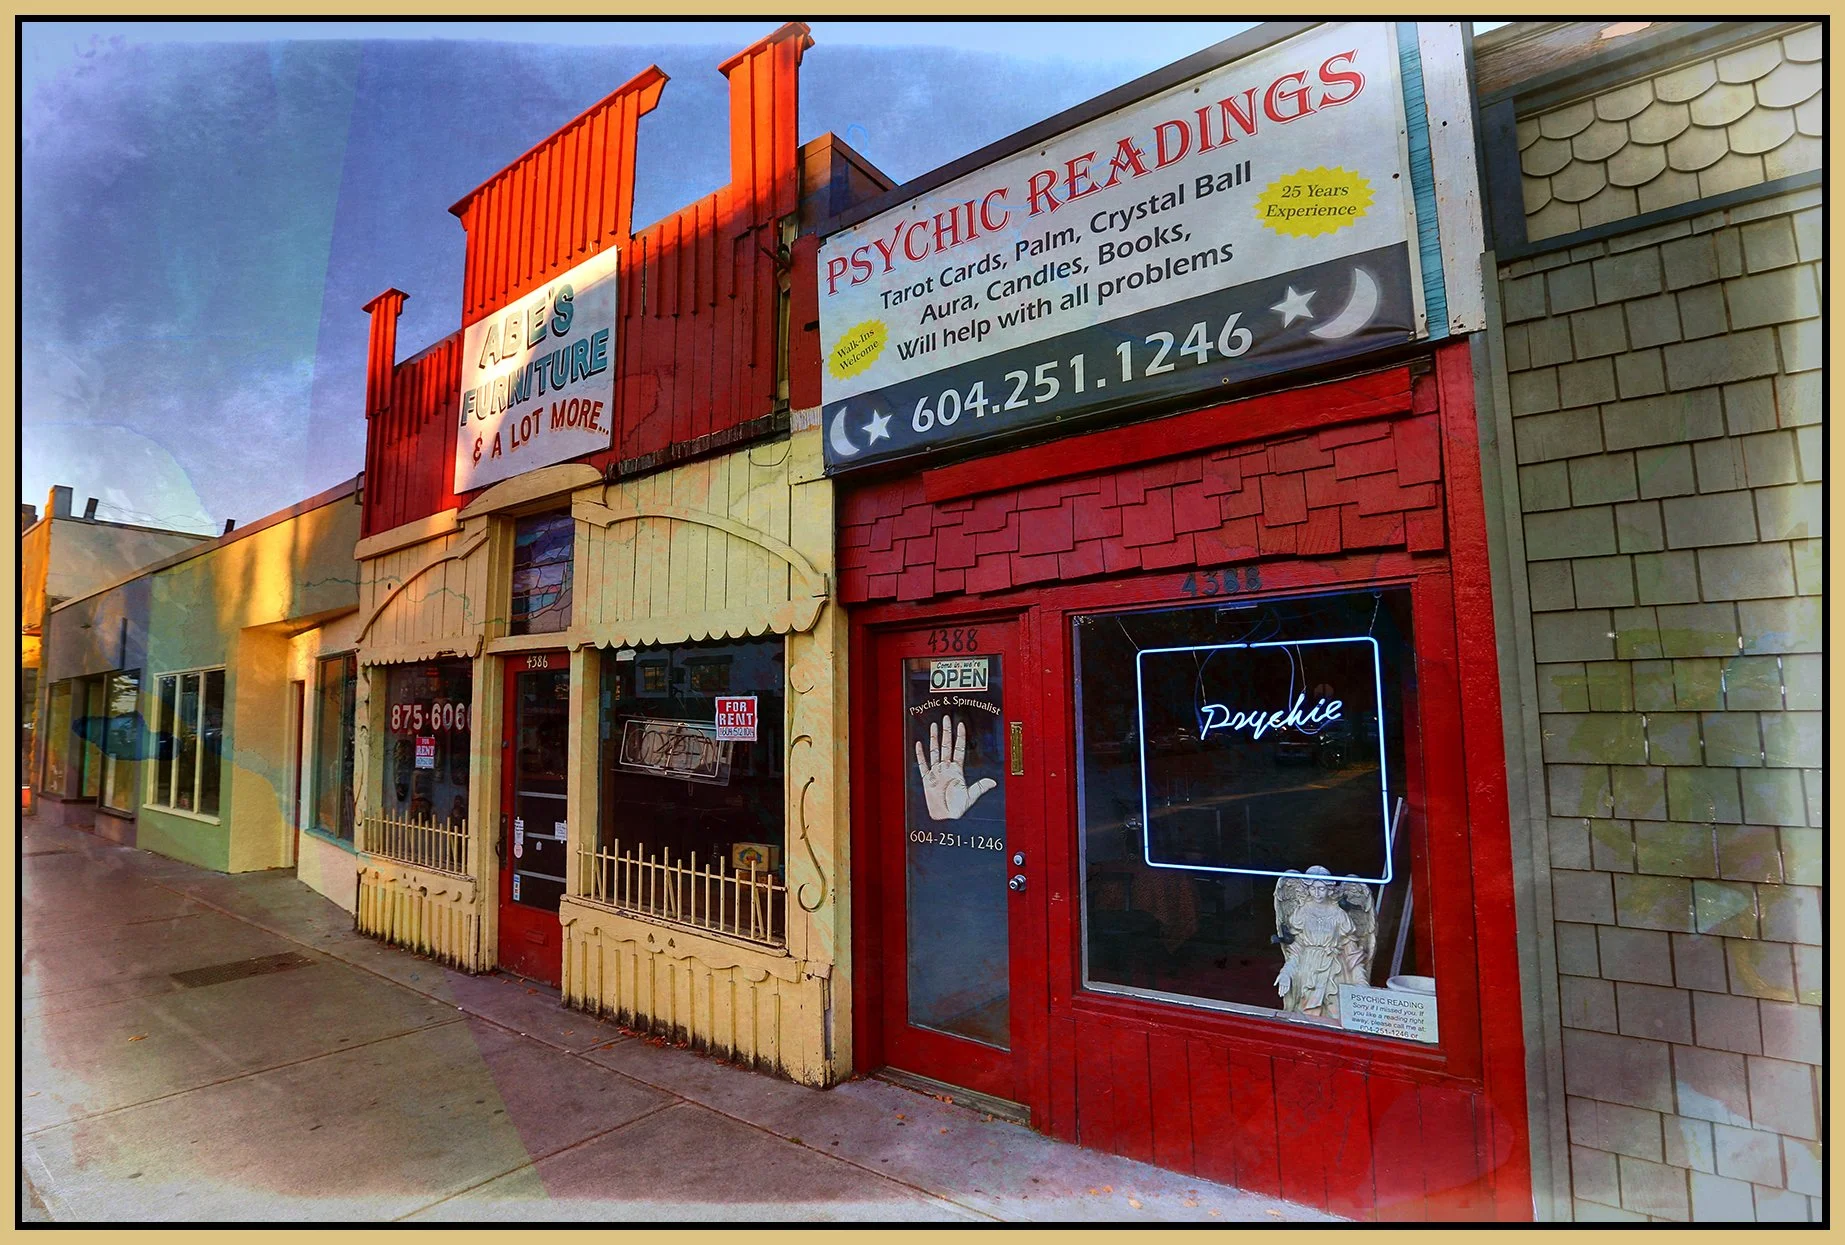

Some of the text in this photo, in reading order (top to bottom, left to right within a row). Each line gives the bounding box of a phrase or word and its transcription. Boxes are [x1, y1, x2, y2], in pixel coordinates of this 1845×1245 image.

[826, 48, 1366, 297] PSYCHIC READINGS
[1281, 184, 1349, 198] 25 Years
[1266, 203, 1357, 220] Experience
[880, 160, 1251, 310] Tarot Cards, Palm, Crystal Ball
[919, 223, 1192, 325] Aura, Candles, Books,
[896, 243, 1234, 362] Will help with all problems
[479, 283, 575, 369] ABE'S
[837, 329, 875, 358] Walk-Ins
[839, 340, 879, 370] Welcome
[460, 327, 610, 427] FURNITURE
[911, 311, 1253, 433] 604.251.1246
[491, 431, 503, 459] A
[511, 407, 544, 450] LOT
[550, 397, 610, 436] MORE...
[1181, 567, 1262, 597] 4388
[927, 628, 979, 653] 4388
[526, 655, 549, 669] 4386
[931, 667, 987, 689] OPEN
[725, 701, 747, 712] FOR
[909, 695, 1001, 716] Psychic & Spiritualist
[719, 713, 753, 726] RENT
[415, 745, 435, 756] RENT
[909, 829, 1003, 851] 604-251-1246
[1351, 993, 1424, 1010] PSYCHIC READING
[1352, 1002, 1369, 1011] Sorry
[1379, 1006, 1403, 1014] missed
[1365, 1010, 1377, 1018] like
[1383, 1014, 1408, 1024] reading
[1409, 1016, 1425, 1025] right
[1370, 1019, 1393, 1029] please
